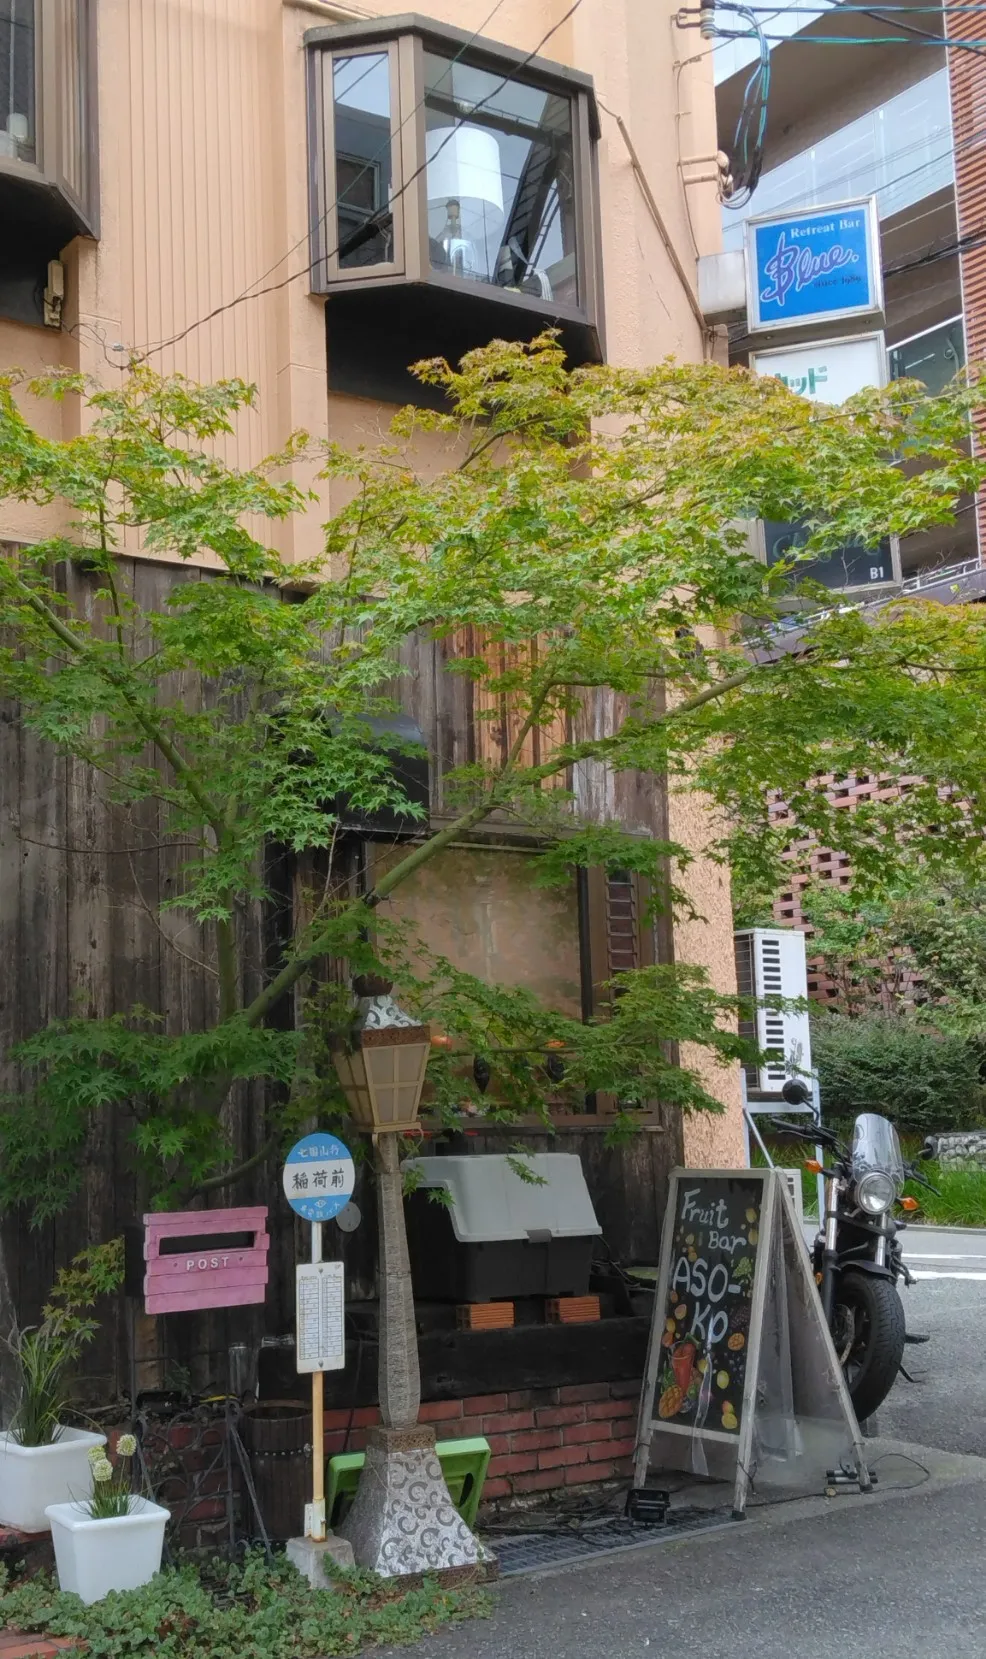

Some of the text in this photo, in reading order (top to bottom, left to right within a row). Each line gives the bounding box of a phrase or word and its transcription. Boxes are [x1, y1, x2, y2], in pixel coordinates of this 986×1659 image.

[791, 219, 861, 239] Retreat Bar
[869, 566, 885, 580] B1
[291, 1167, 345, 1191] 稲荷前
[681, 1188, 729, 1229] Fruit
[707, 1230, 747, 1255] Bar
[186, 1256, 229, 1271] POST
